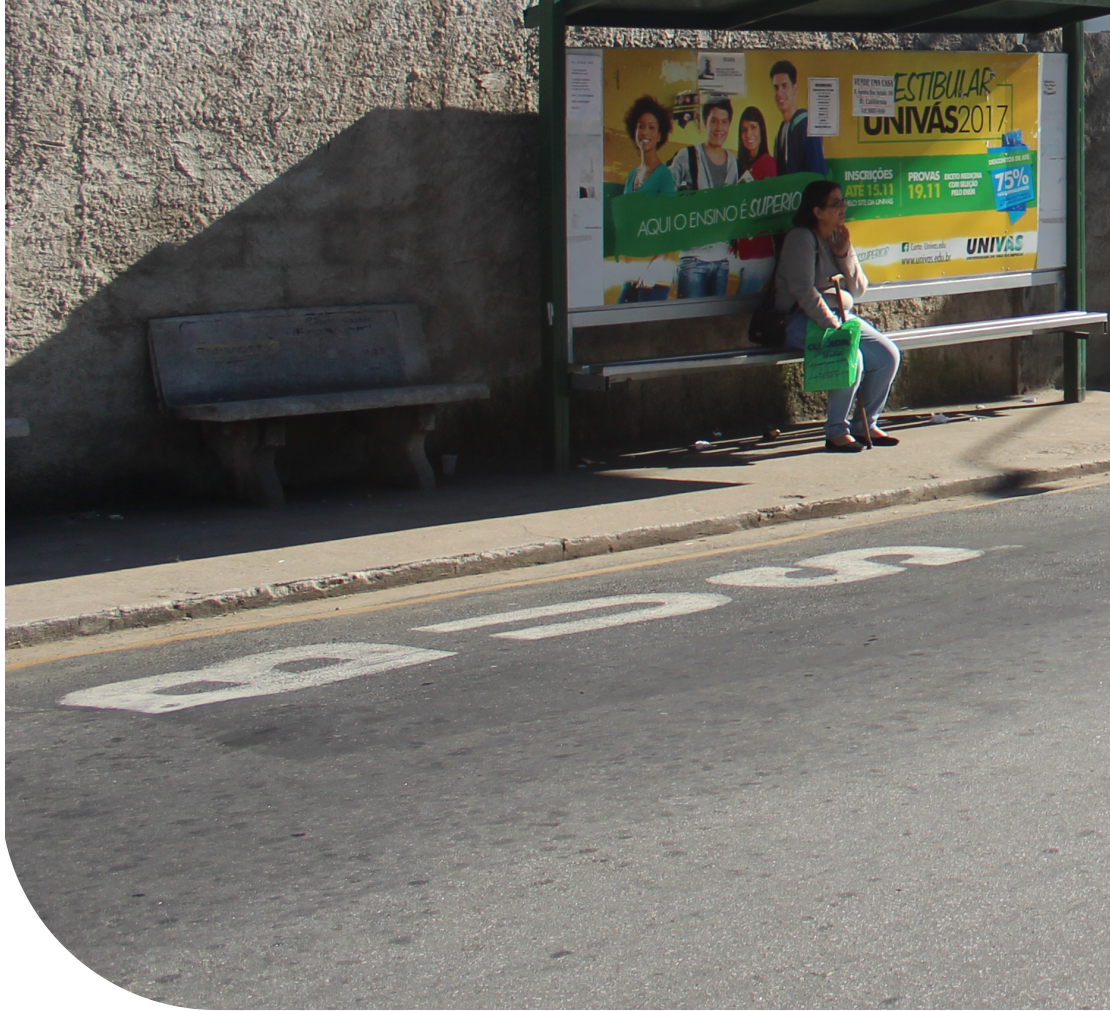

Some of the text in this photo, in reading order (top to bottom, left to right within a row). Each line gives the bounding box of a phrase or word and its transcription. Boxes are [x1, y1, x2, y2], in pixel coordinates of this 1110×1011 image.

[881, 79, 893, 87] CASA
[894, 67, 996, 103] ESTIBULAR
[844, 168, 893, 182] INSCRIÇÕES
[907, 171, 940, 181] PROVAS
[994, 167, 1029, 191] 75%
[845, 181, 894, 197] ATÉ 15.11
[908, 183, 940, 199] 19.11
[637, 191, 802, 237] AQUI O ENSINO É SUPERIO
